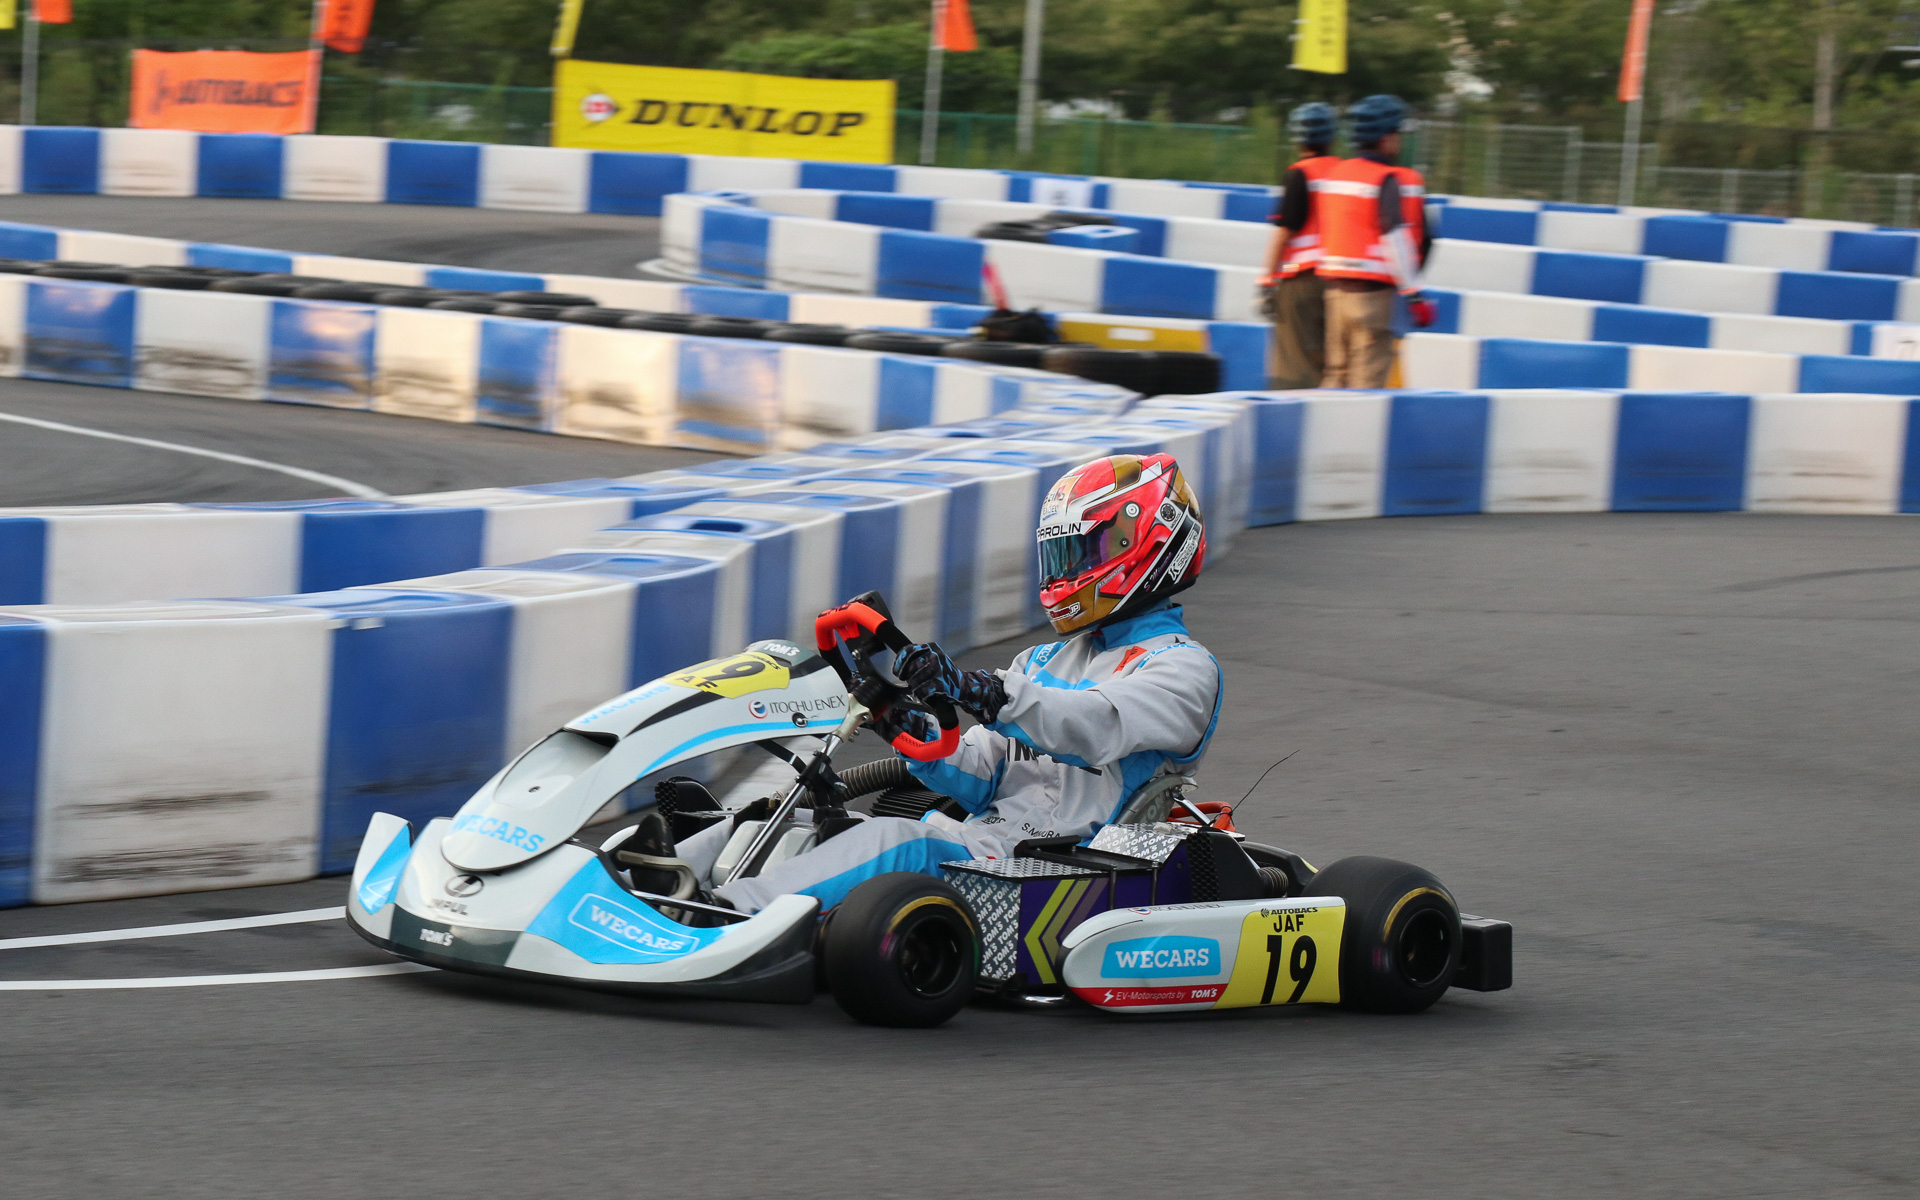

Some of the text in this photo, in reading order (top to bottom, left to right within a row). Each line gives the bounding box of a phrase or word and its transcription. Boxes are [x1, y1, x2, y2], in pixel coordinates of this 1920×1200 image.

[627, 98, 867, 137] DUNLOP
[1037, 522, 1082, 539] PAROLIN
[763, 642, 800, 657] TOM'S
[769, 694, 846, 714] ITOCHU ENEX
[452, 813, 546, 853] WECARS
[987, 900, 1008, 926] TOM'S
[1270, 906, 1319, 916] AUTOBACS
[1273, 914, 1305, 933] JAF
[590, 904, 685, 951] WECARS
[982, 921, 1003, 946] TOM'S
[998, 920, 1019, 945] TOM'S
[993, 940, 1014, 965] TOM'S
[1115, 947, 1210, 969] WECARS
[1260, 934, 1317, 1005] 19
[1115, 987, 1218, 1001] EV-Motorsports by TOM'S
